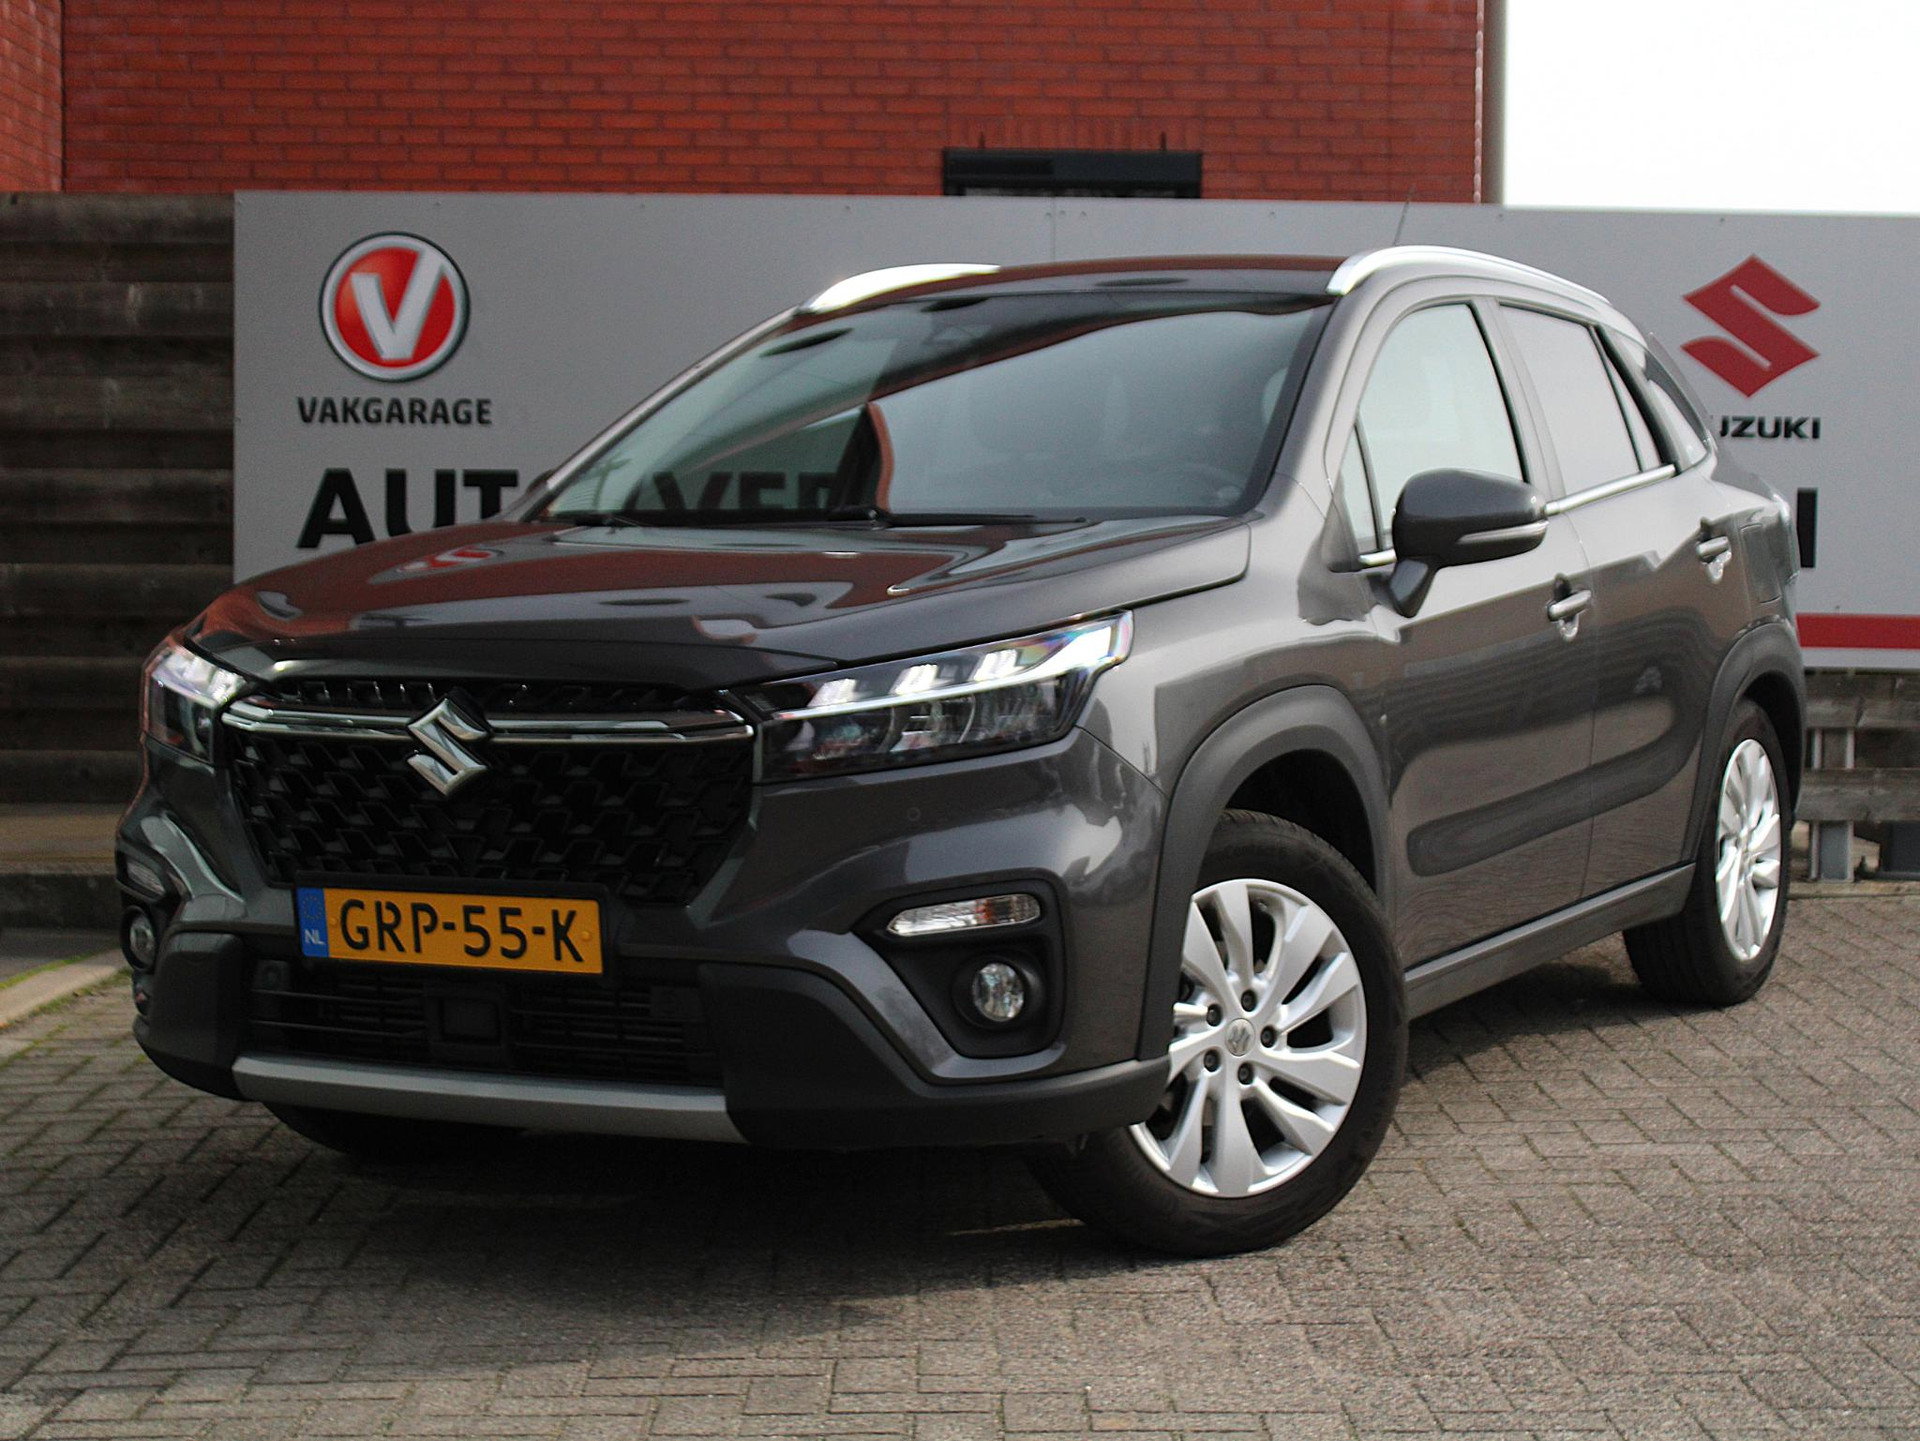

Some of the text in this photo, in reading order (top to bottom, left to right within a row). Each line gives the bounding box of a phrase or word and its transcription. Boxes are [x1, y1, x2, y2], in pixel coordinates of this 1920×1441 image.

[298, 396, 492, 425] VAKGARAGE
[1711, 415, 1821, 439] ZUKI
[296, 467, 518, 548] AUT
[304, 898, 584, 963] NL GRP-55-K
